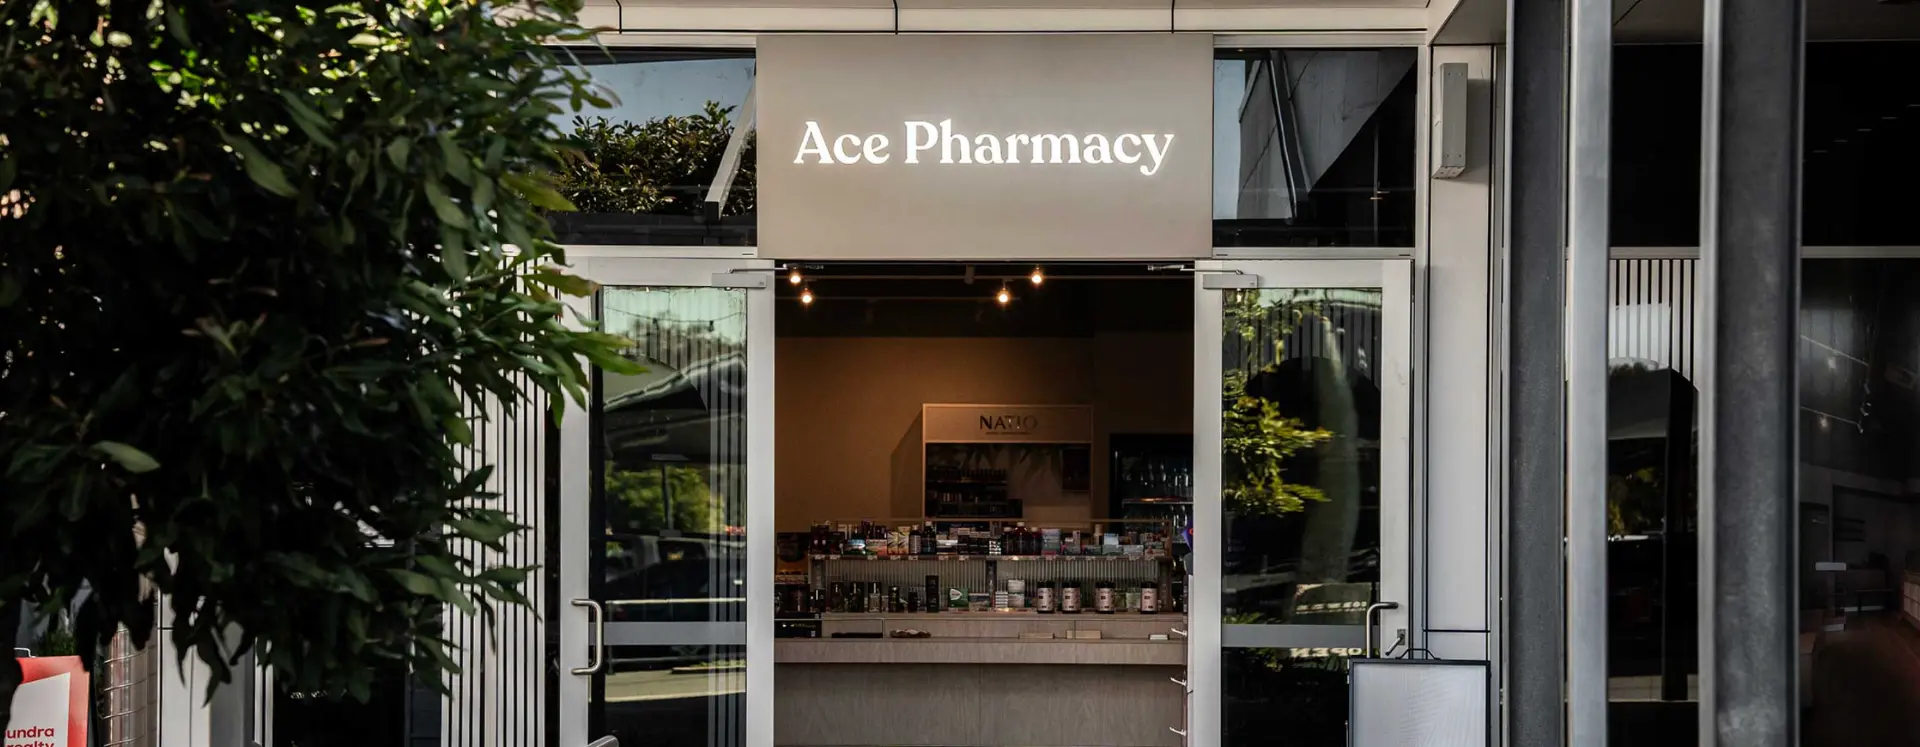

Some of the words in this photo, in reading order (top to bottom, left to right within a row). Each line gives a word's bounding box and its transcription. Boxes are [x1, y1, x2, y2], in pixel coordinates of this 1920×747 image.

[793, 120, 890, 164] Ace
[903, 118, 1175, 176] Pharmacy
[979, 414, 1039, 430] NATIO
[4, 726, 54, 740] undra
